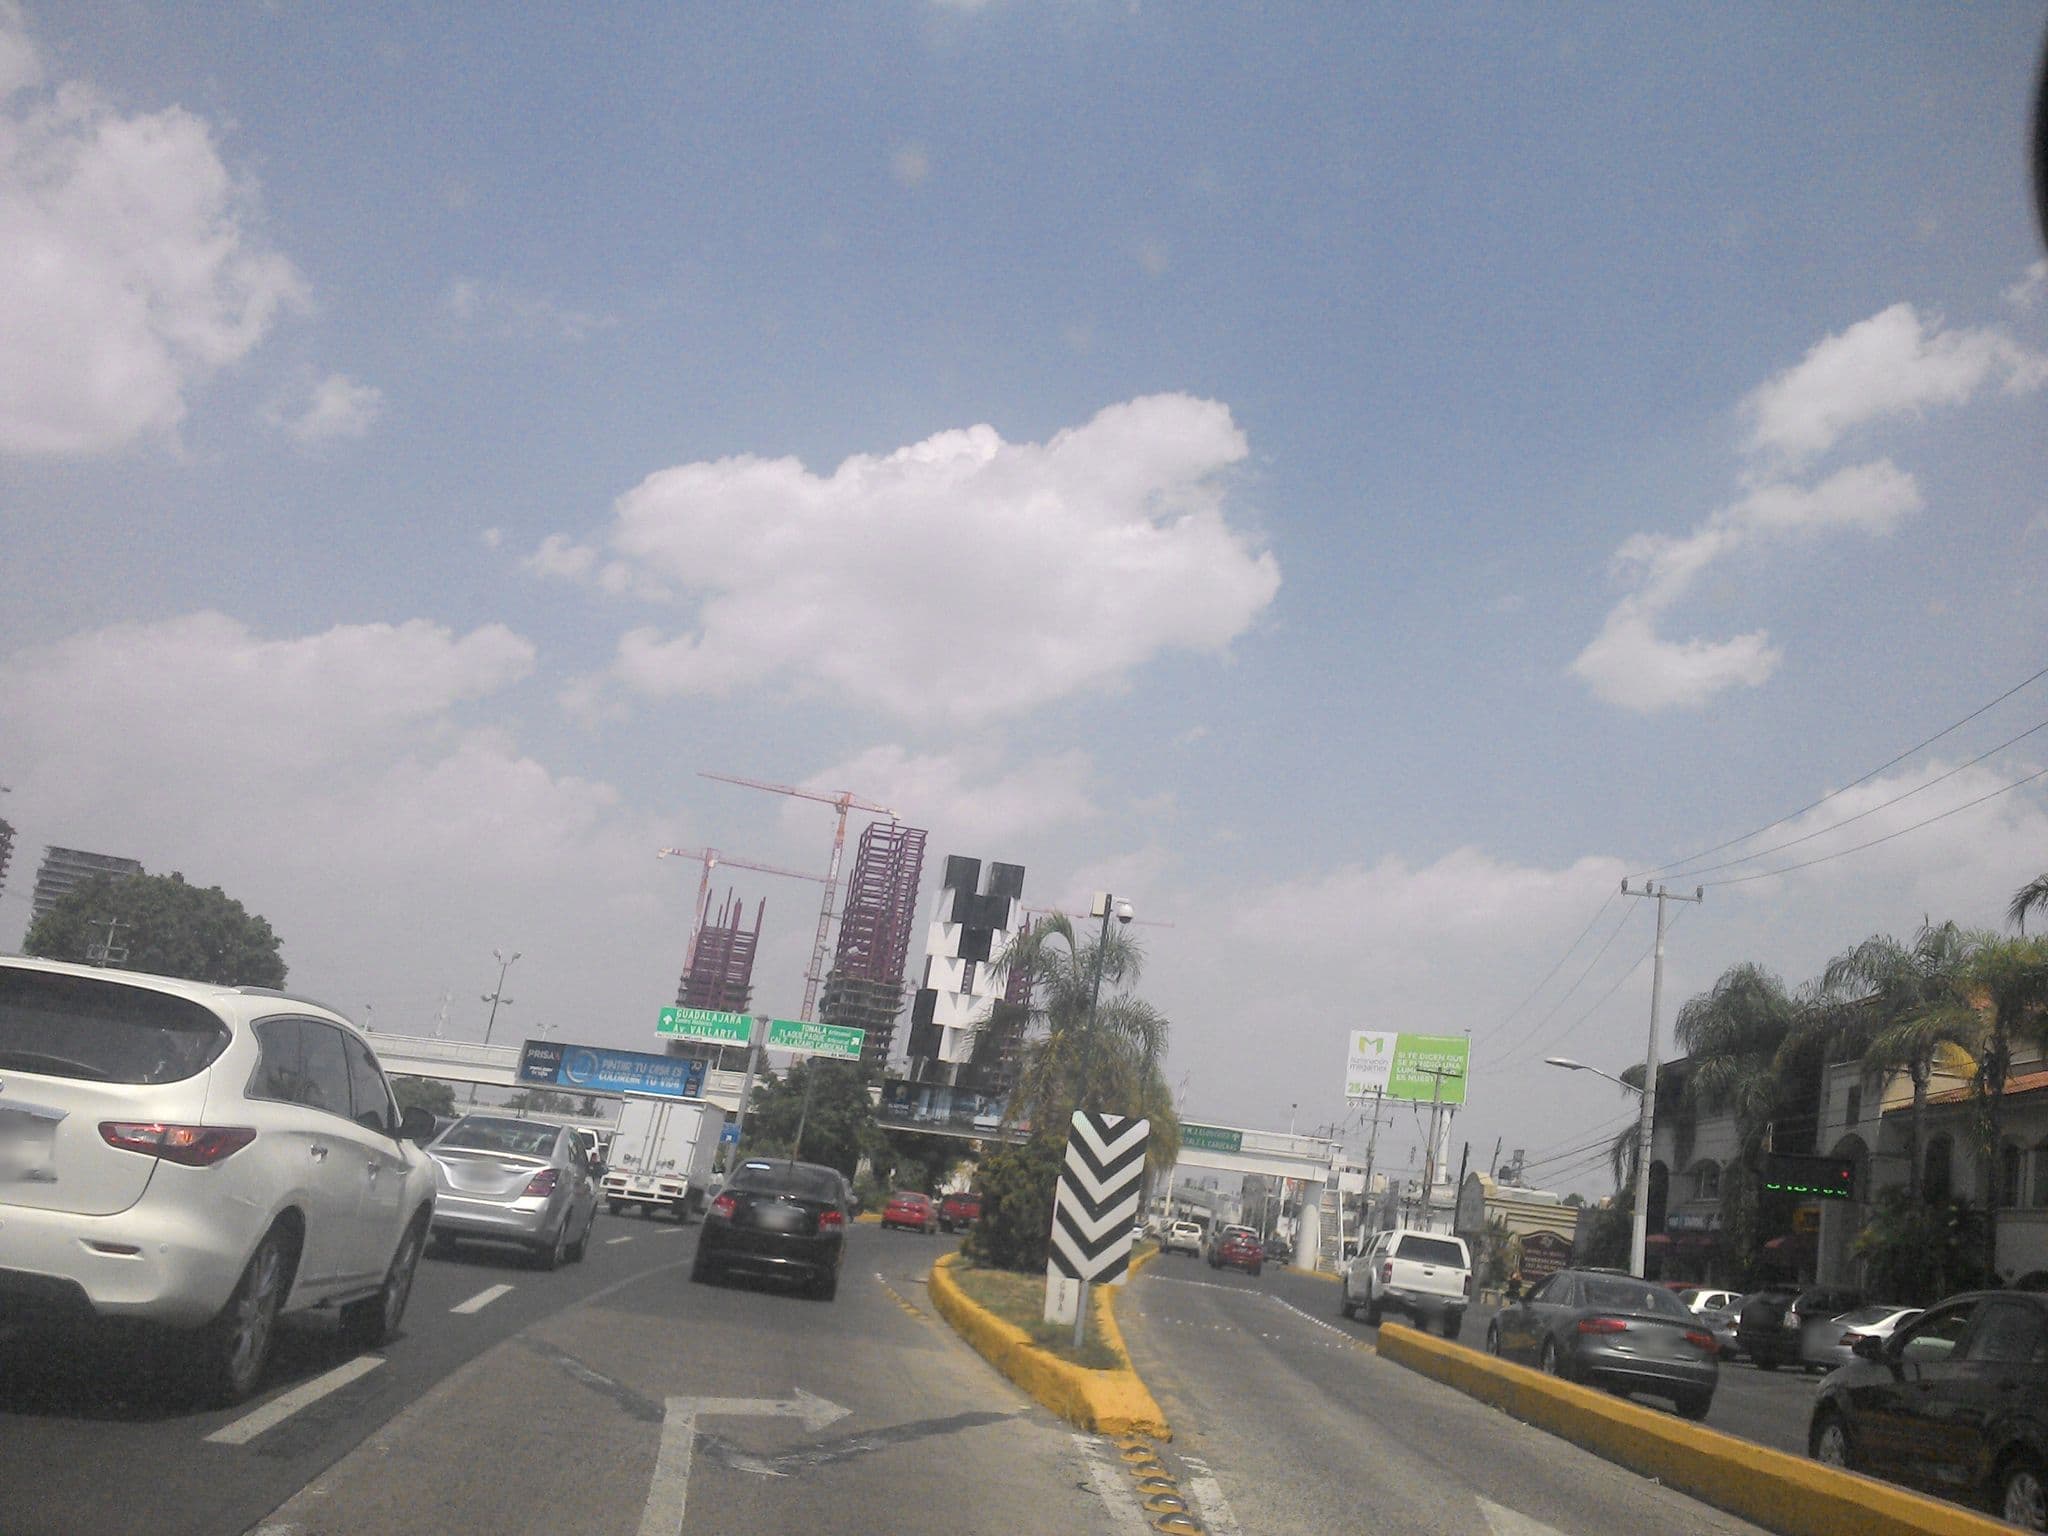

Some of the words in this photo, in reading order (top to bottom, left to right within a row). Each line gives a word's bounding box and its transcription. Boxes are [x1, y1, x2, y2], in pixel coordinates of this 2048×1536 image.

[676, 1009, 742, 1025] GUADALAJARA
[690, 1025, 738, 1040] VALLARTA
[528, 1049, 555, 1060] PRISA
[636, 1062, 647, 1073] TU
[599, 1072, 641, 1085] COLOREAR
[646, 1076, 657, 1087] TU
[660, 1077, 680, 1088] VIDA
